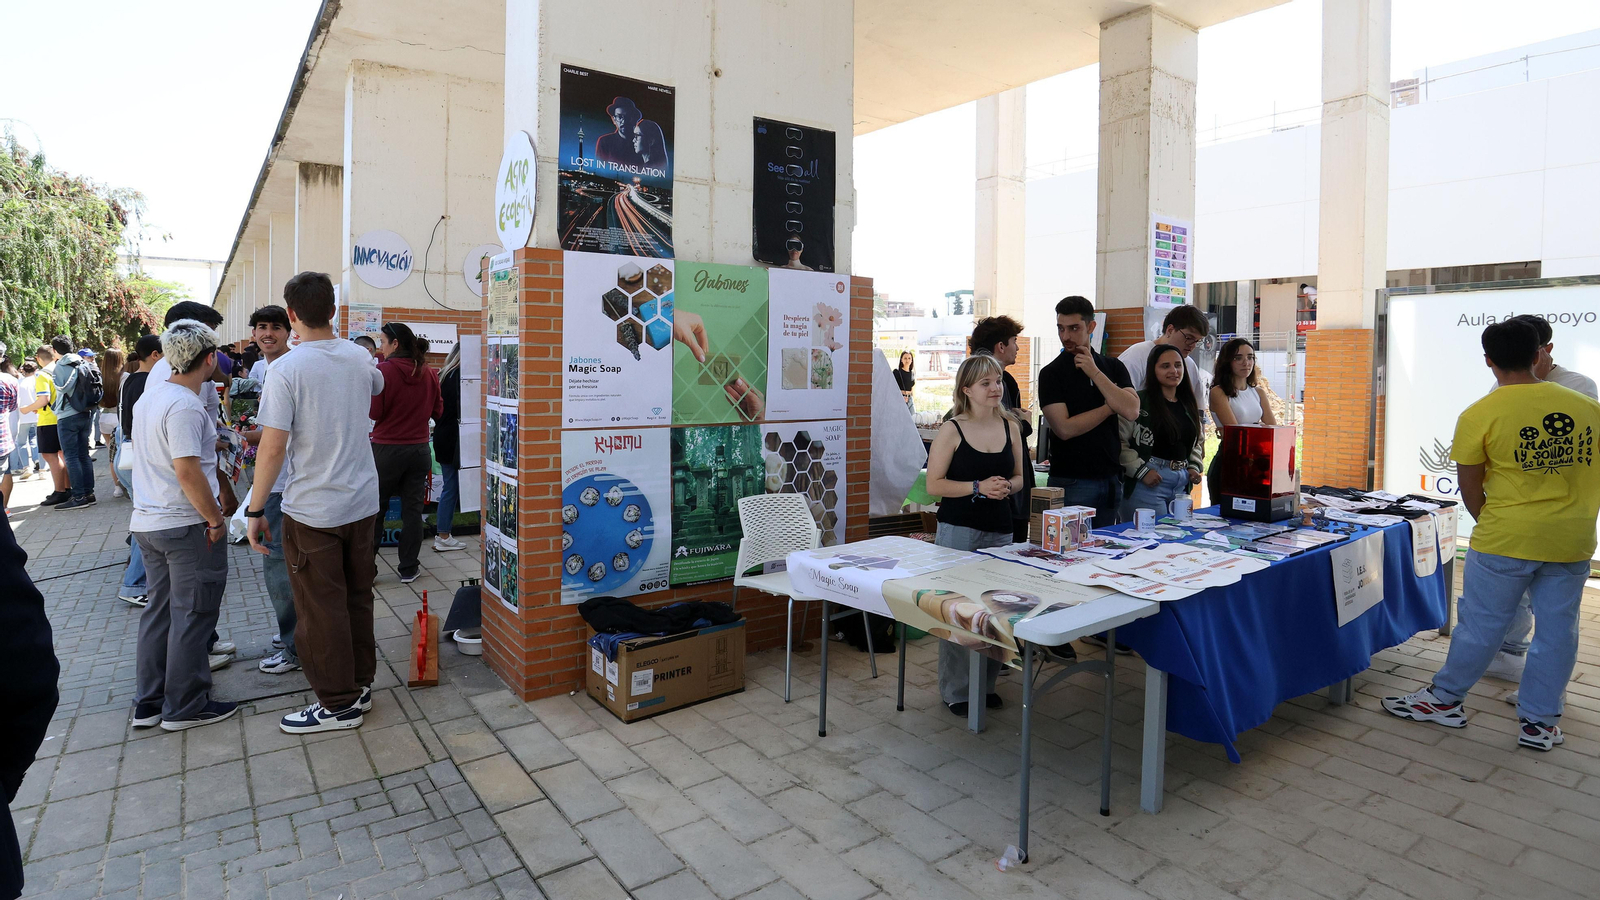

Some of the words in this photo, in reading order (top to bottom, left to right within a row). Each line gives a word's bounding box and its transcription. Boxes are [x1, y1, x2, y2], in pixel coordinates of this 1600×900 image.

[570, 156, 594, 167] LOST
[596, 160, 606, 169] IN
[608, 162, 666, 178] TRANSLATION
[767, 162, 784, 173] See
[353, 244, 412, 272] INNOVACIÓN
[694, 270, 750, 293] Jabones
[784, 314, 809, 323] Despierta
[1457, 312, 1496, 326] Aula
[569, 356, 602, 364] Jabones
[569, 365, 597, 374] Magic
[600, 364, 622, 374] Soap
[1519, 436, 1574, 450] IMAGEN
[1532, 446, 1574, 459] SONIDO
[1419, 474, 1461, 495] UC
[690, 543, 731, 554] FUJIWARA
[809, 568, 836, 586] Magic
[838, 576, 859, 593] Soap
[636, 658, 659, 668] ELEGOO
[654, 666, 692, 683] PRINTER
